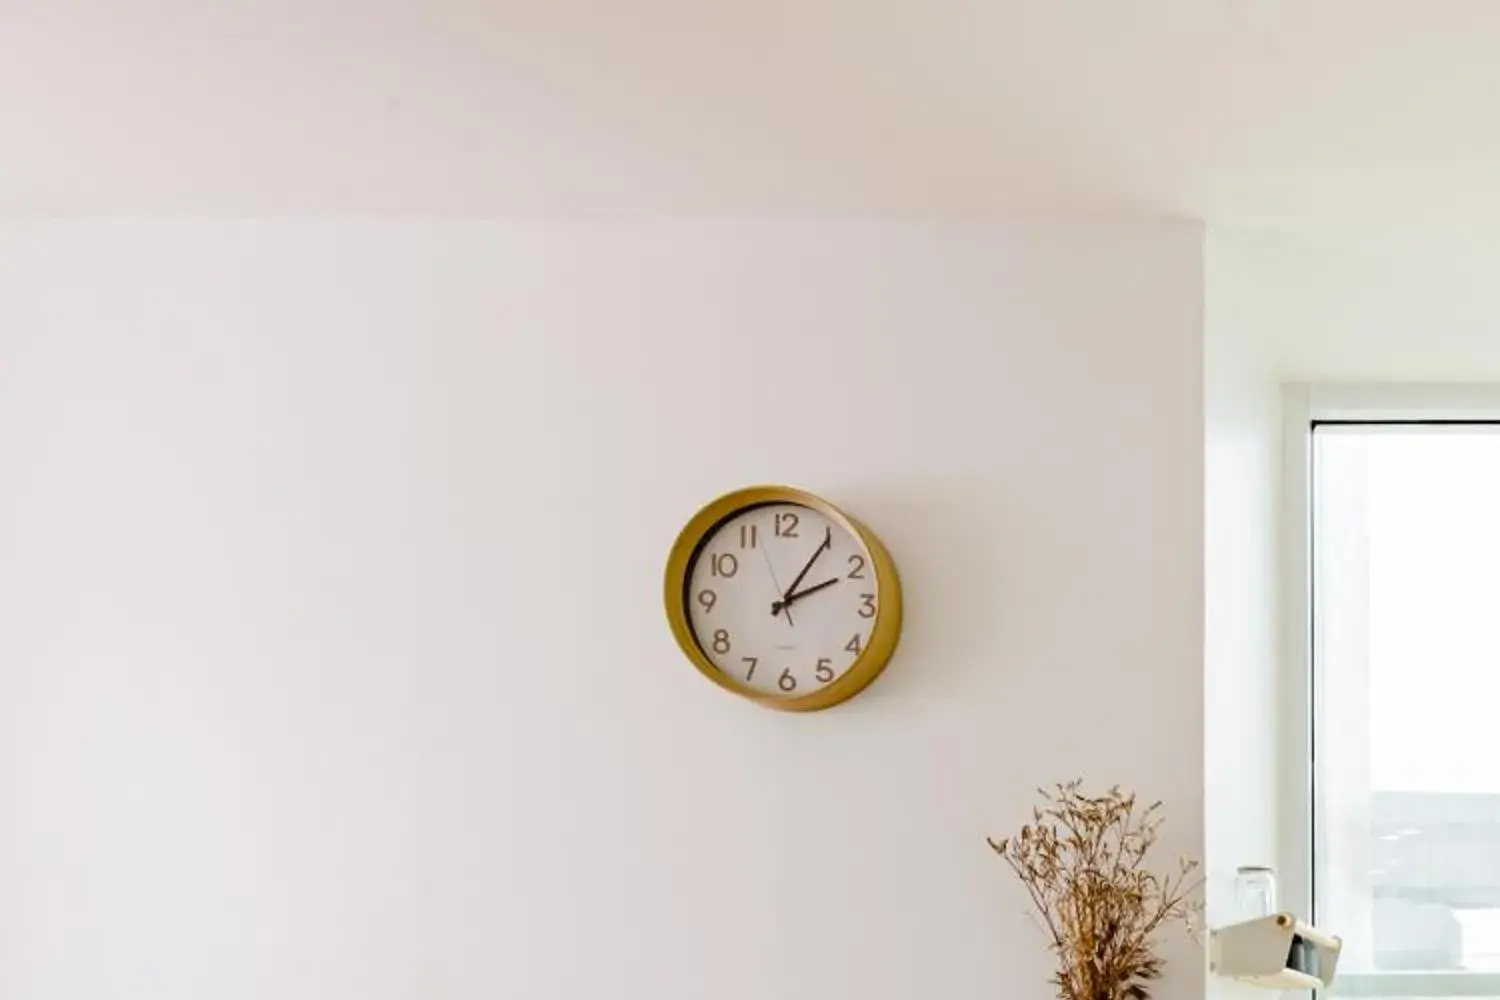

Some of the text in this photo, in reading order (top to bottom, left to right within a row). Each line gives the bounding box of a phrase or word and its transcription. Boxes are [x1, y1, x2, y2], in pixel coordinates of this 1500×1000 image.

[740, 525, 757, 549] 11
[774, 513, 799, 537] 12
[711, 553, 738, 578] 10
[848, 555, 865, 579] 2
[698, 589, 717, 614] 9
[858, 593, 876, 618] 3
[712, 629, 731, 654] 8
[845, 633, 862, 656] 4
[741, 657, 758, 681] 7
[778, 667, 797, 692] 6
[815, 659, 835, 683] 5
